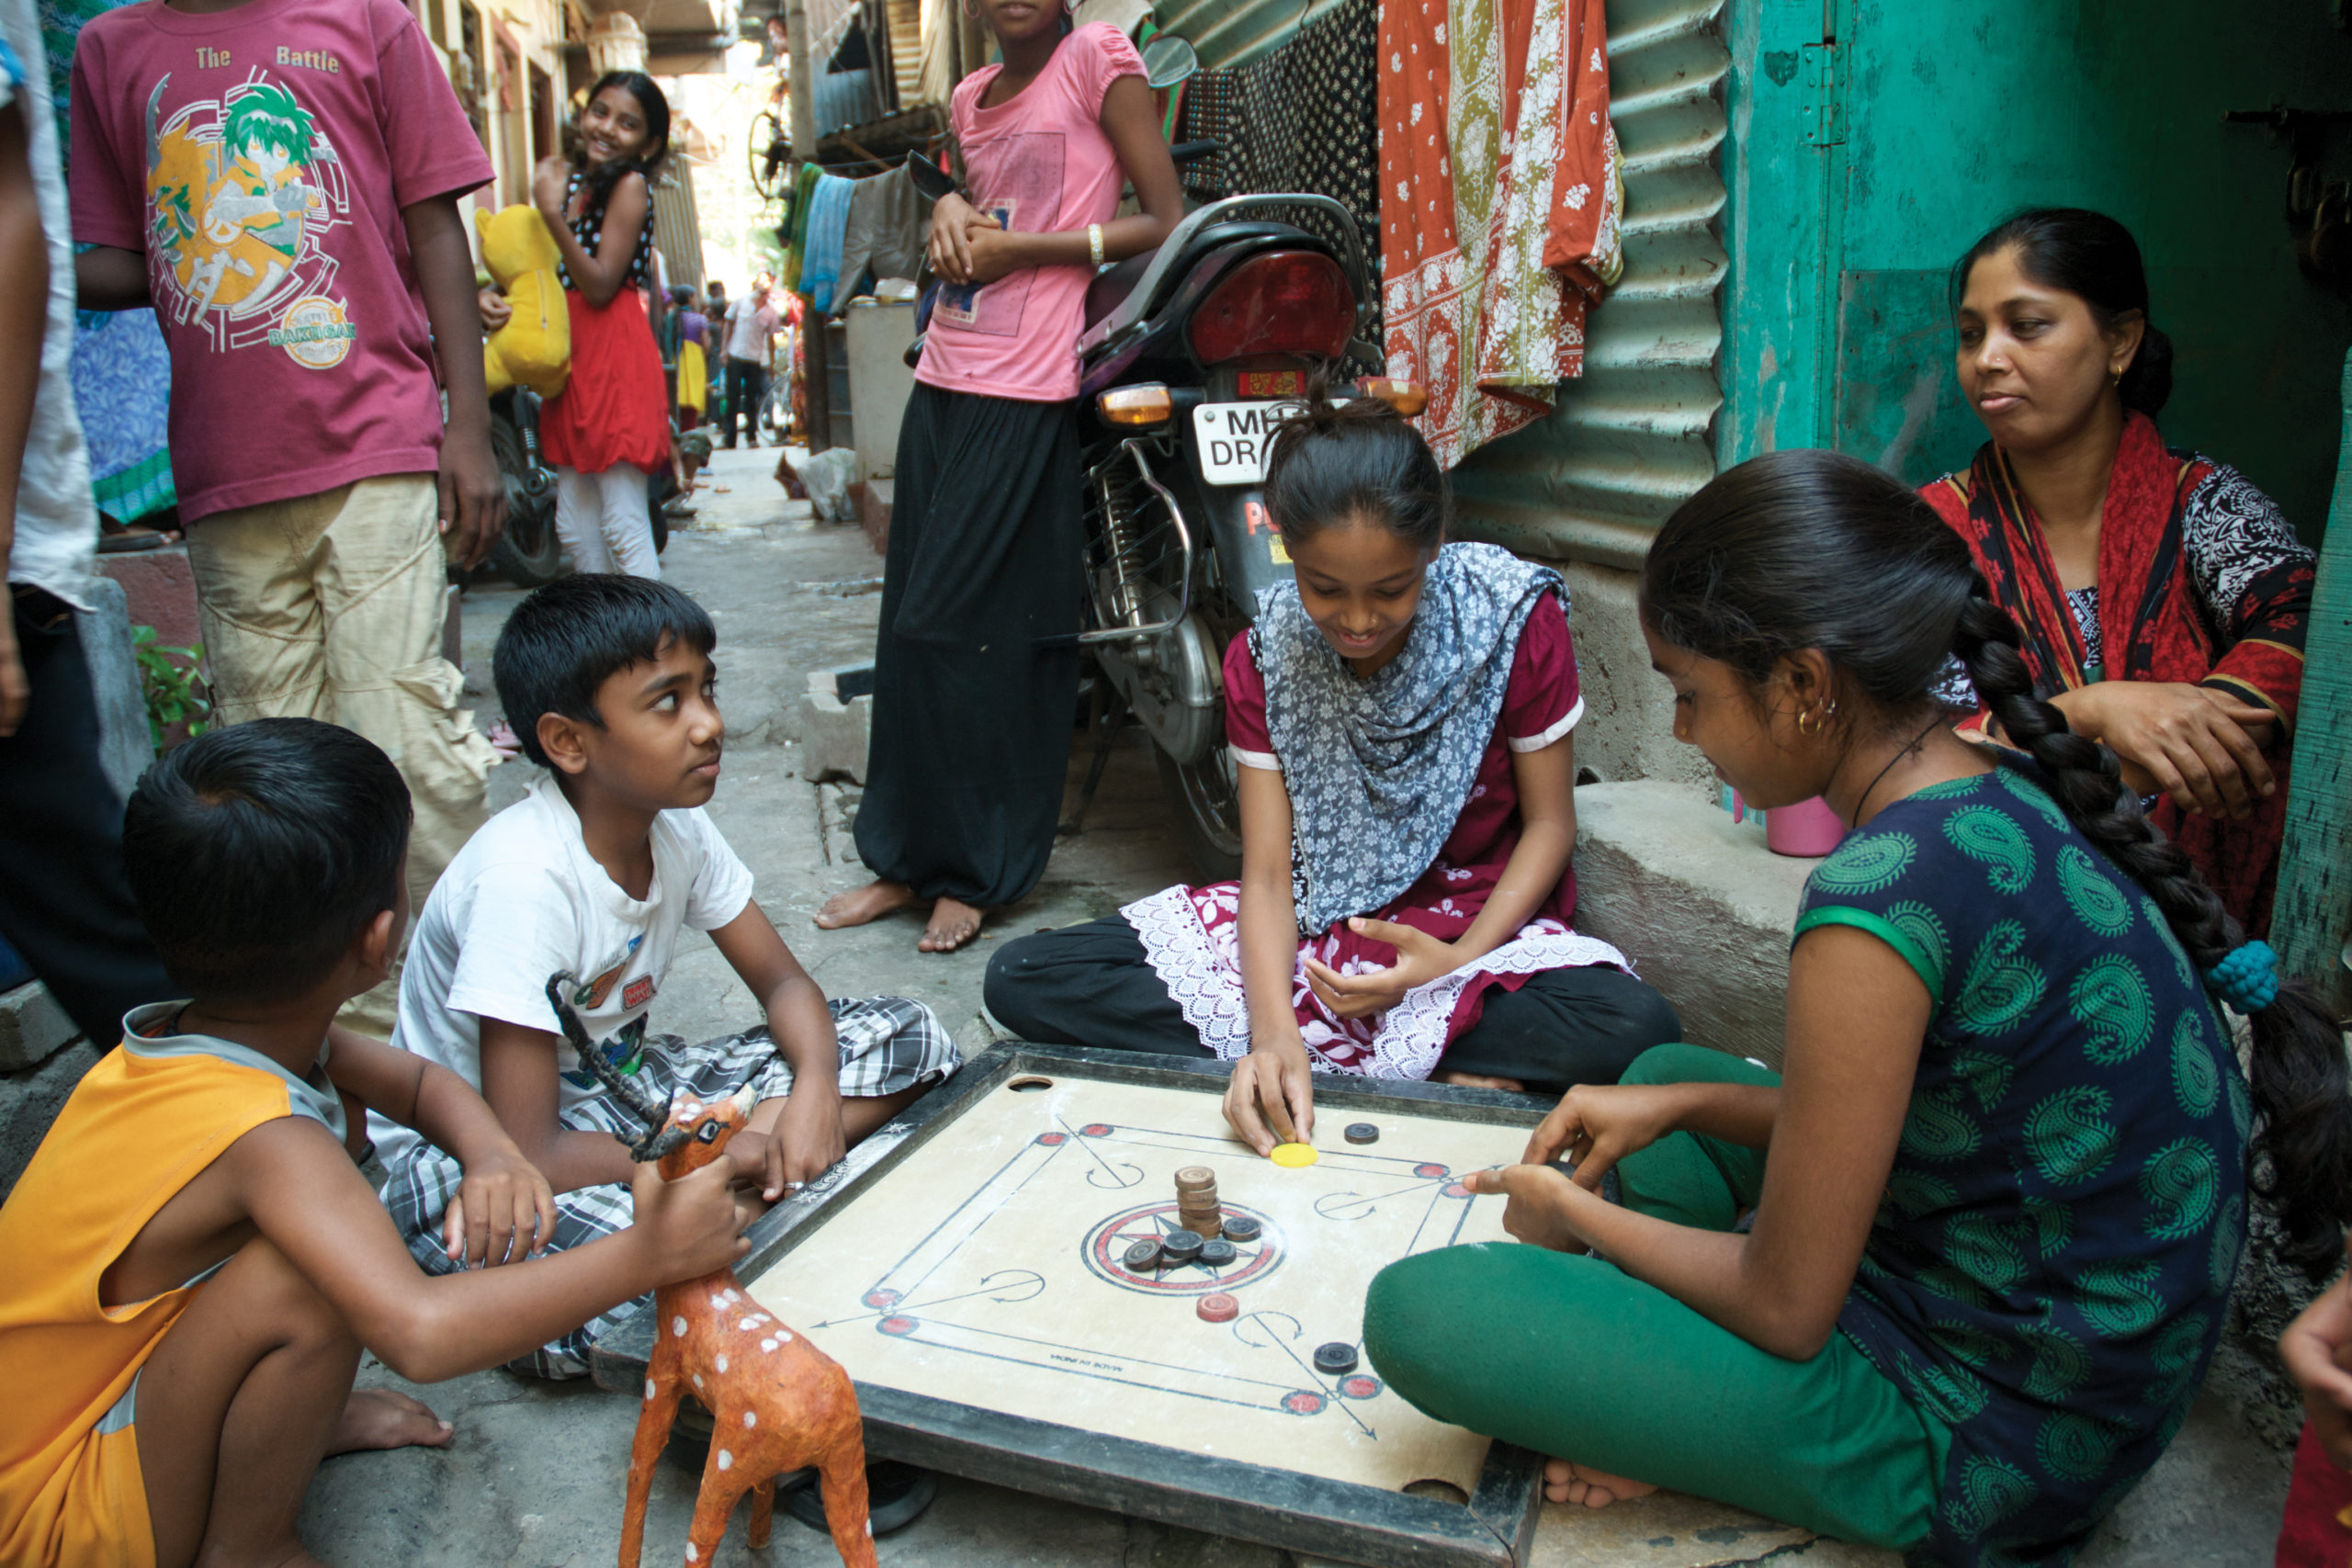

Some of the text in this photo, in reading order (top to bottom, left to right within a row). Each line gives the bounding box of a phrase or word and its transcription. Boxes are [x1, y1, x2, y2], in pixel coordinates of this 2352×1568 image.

[195, 46, 339, 73] The Battle
[1227, 410, 1305, 435] MH
[1210, 439, 1258, 466] DR
[1050, 1353, 1078, 1363] INDIA
